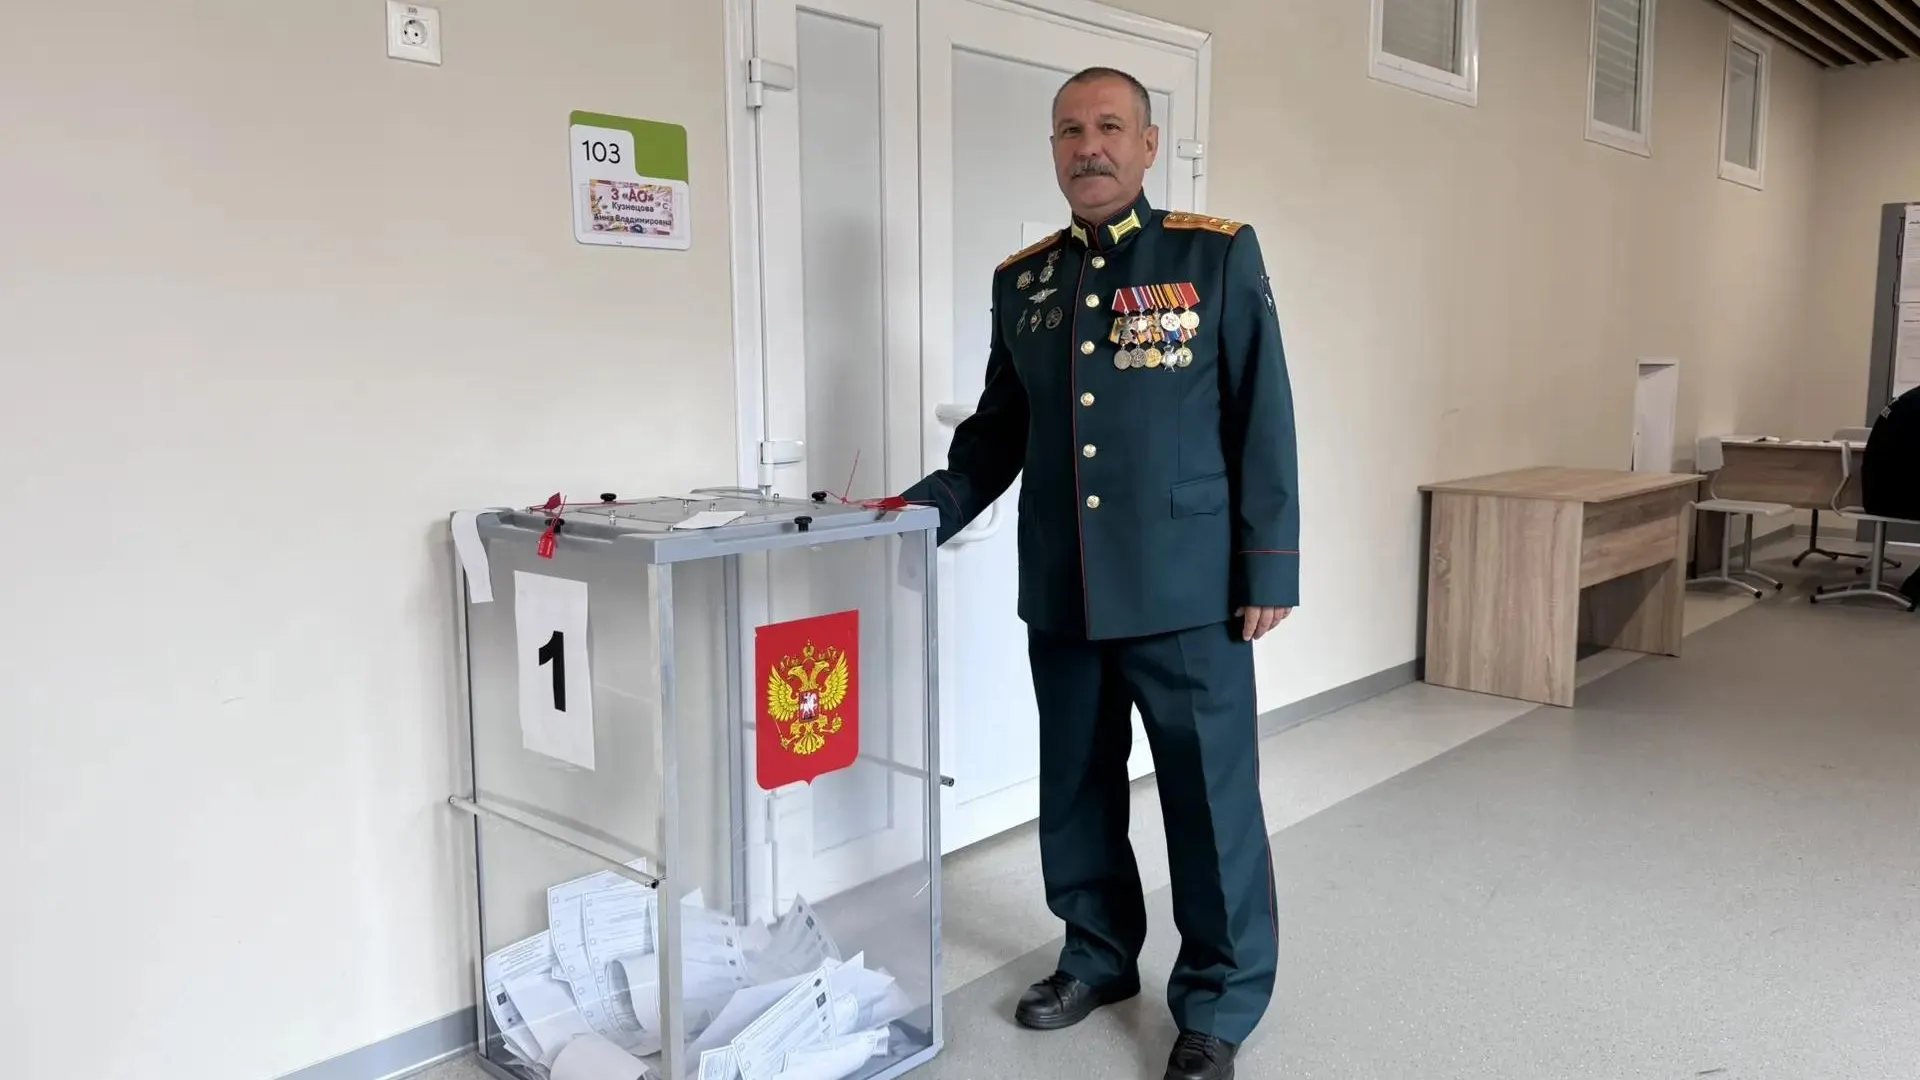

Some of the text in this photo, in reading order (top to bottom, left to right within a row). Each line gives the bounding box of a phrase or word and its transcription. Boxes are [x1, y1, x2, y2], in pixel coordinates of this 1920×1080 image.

[582, 140, 621, 164] 103
[611, 201, 654, 213] Кузнецова
[593, 213, 672, 226] Анна Владимировна
[538, 630, 566, 713] 1
